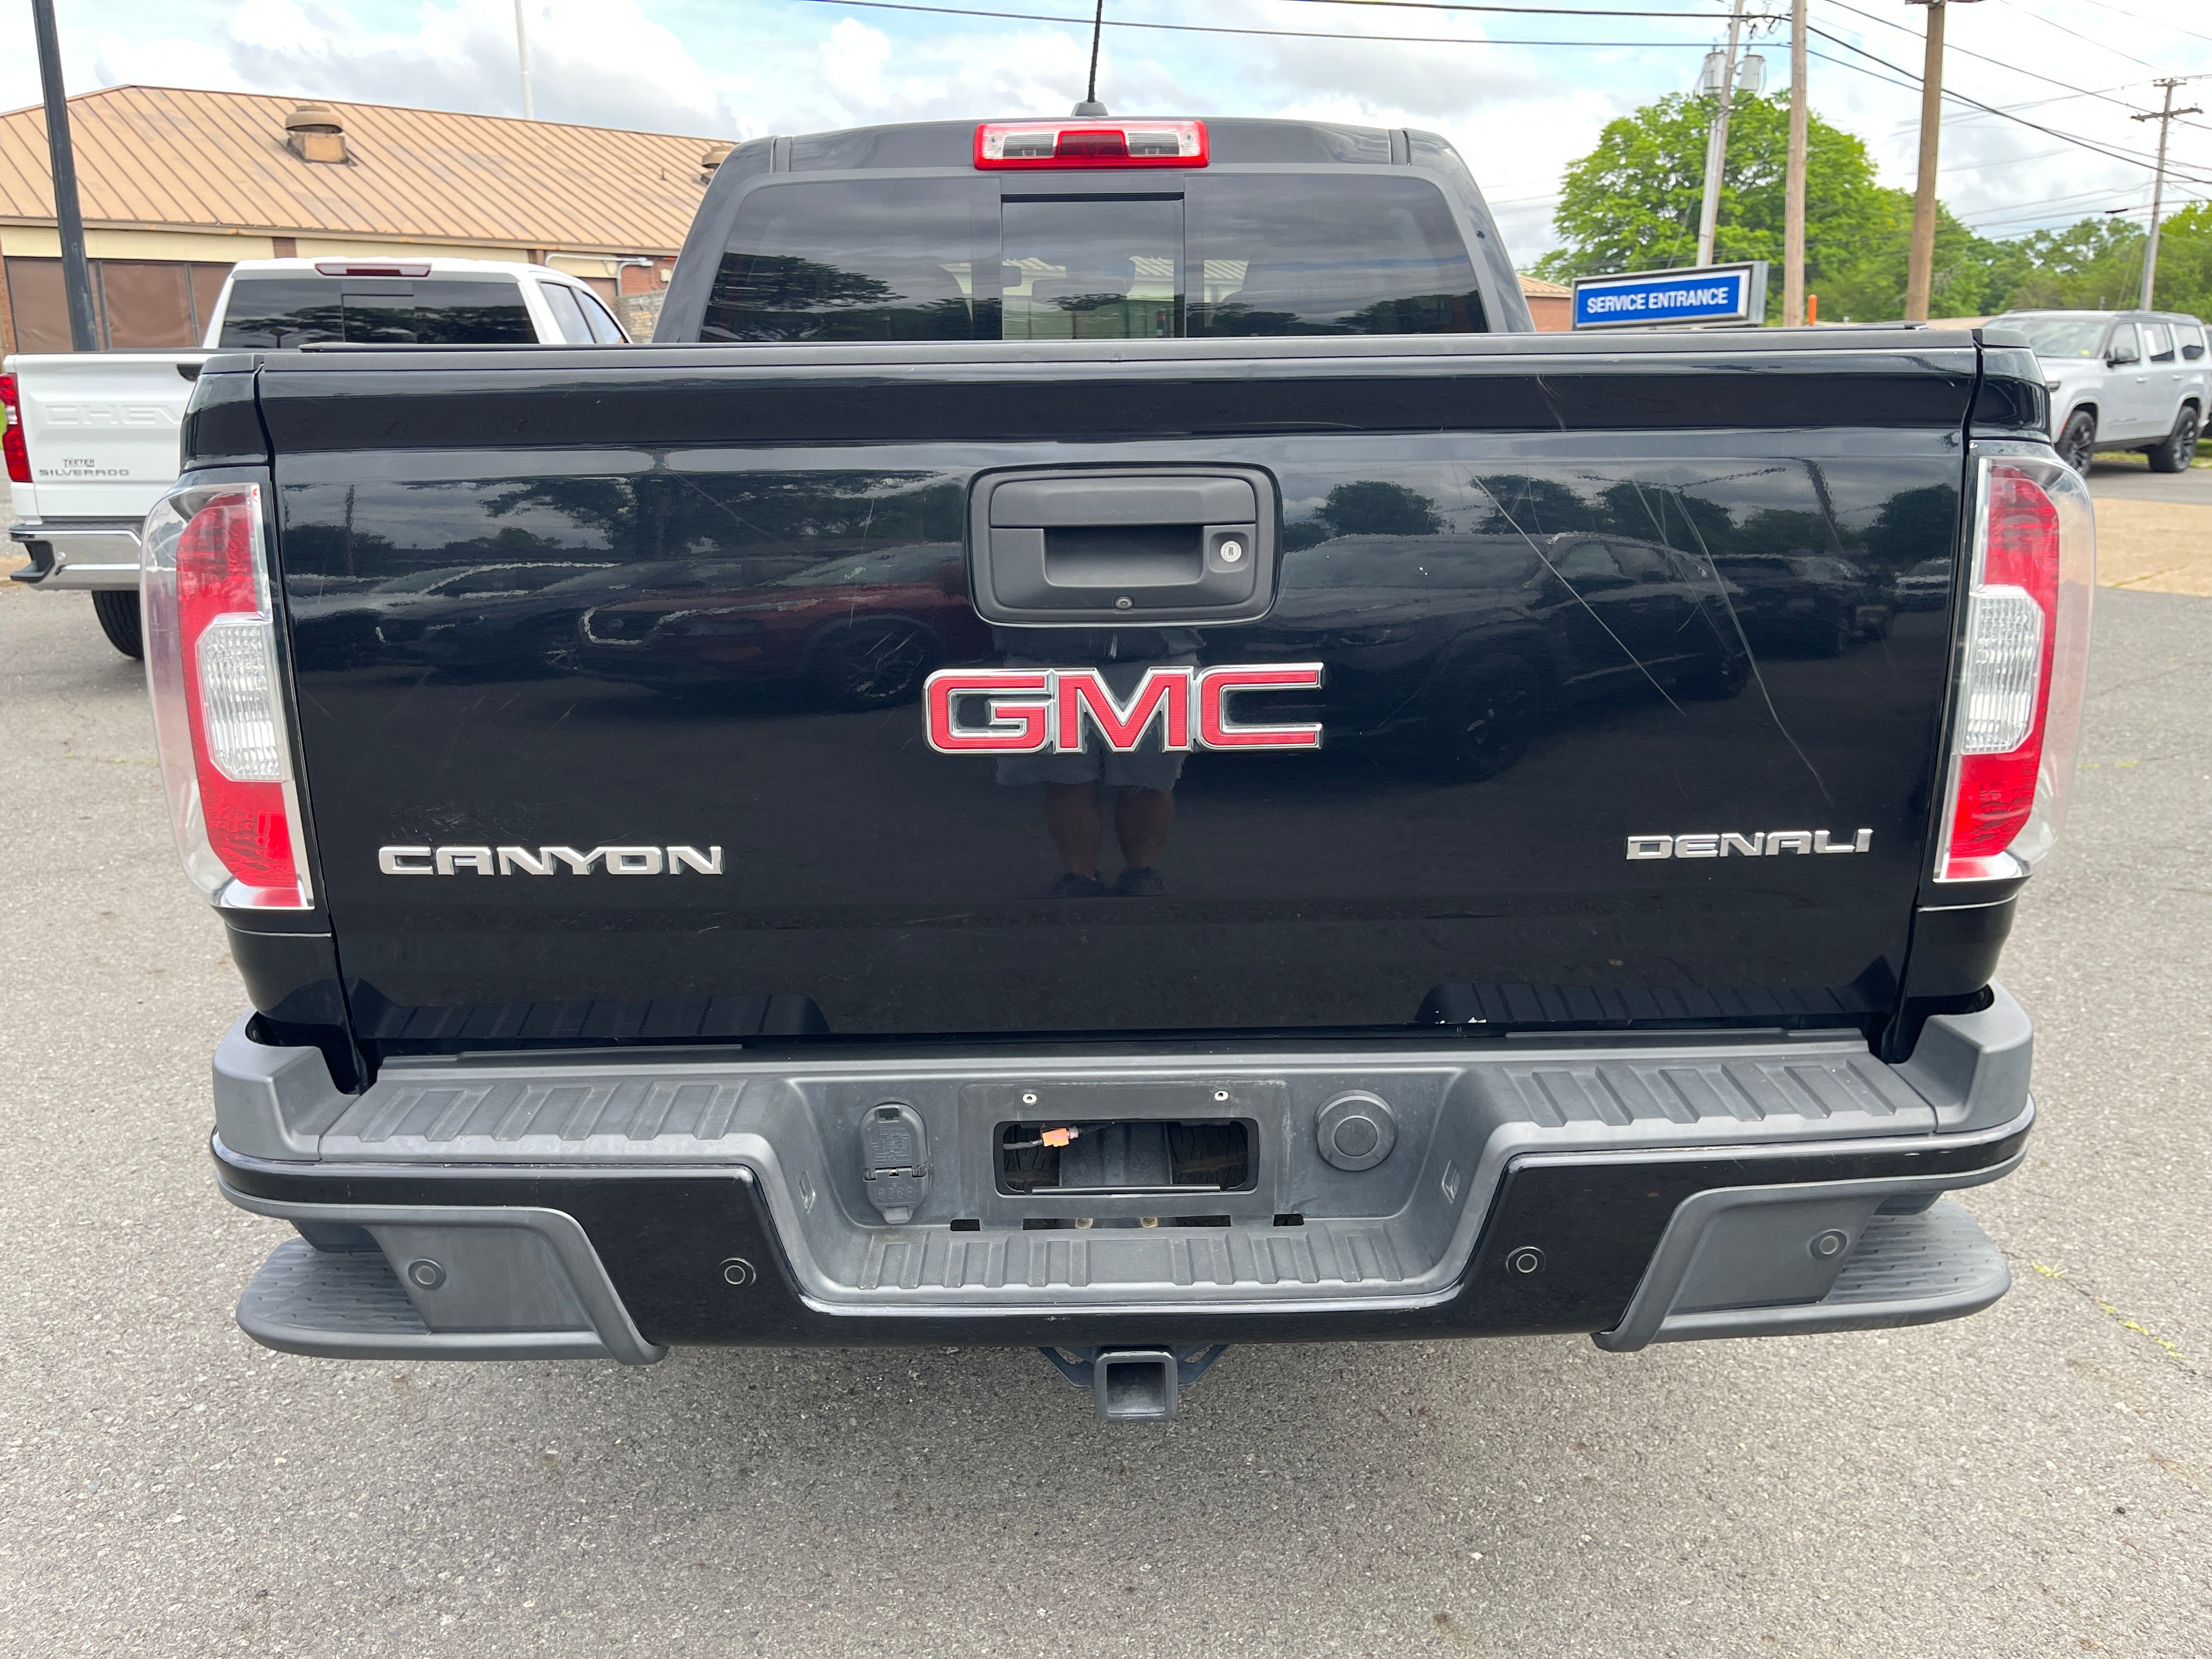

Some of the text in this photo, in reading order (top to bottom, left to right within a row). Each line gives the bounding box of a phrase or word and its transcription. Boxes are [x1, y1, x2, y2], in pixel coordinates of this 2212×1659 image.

[1587, 286, 1729, 313] SERVICE ENTRANCE
[923, 662, 1324, 754] GMC
[1626, 828, 1874, 860] DENALI
[379, 845, 723, 876] CANYON
